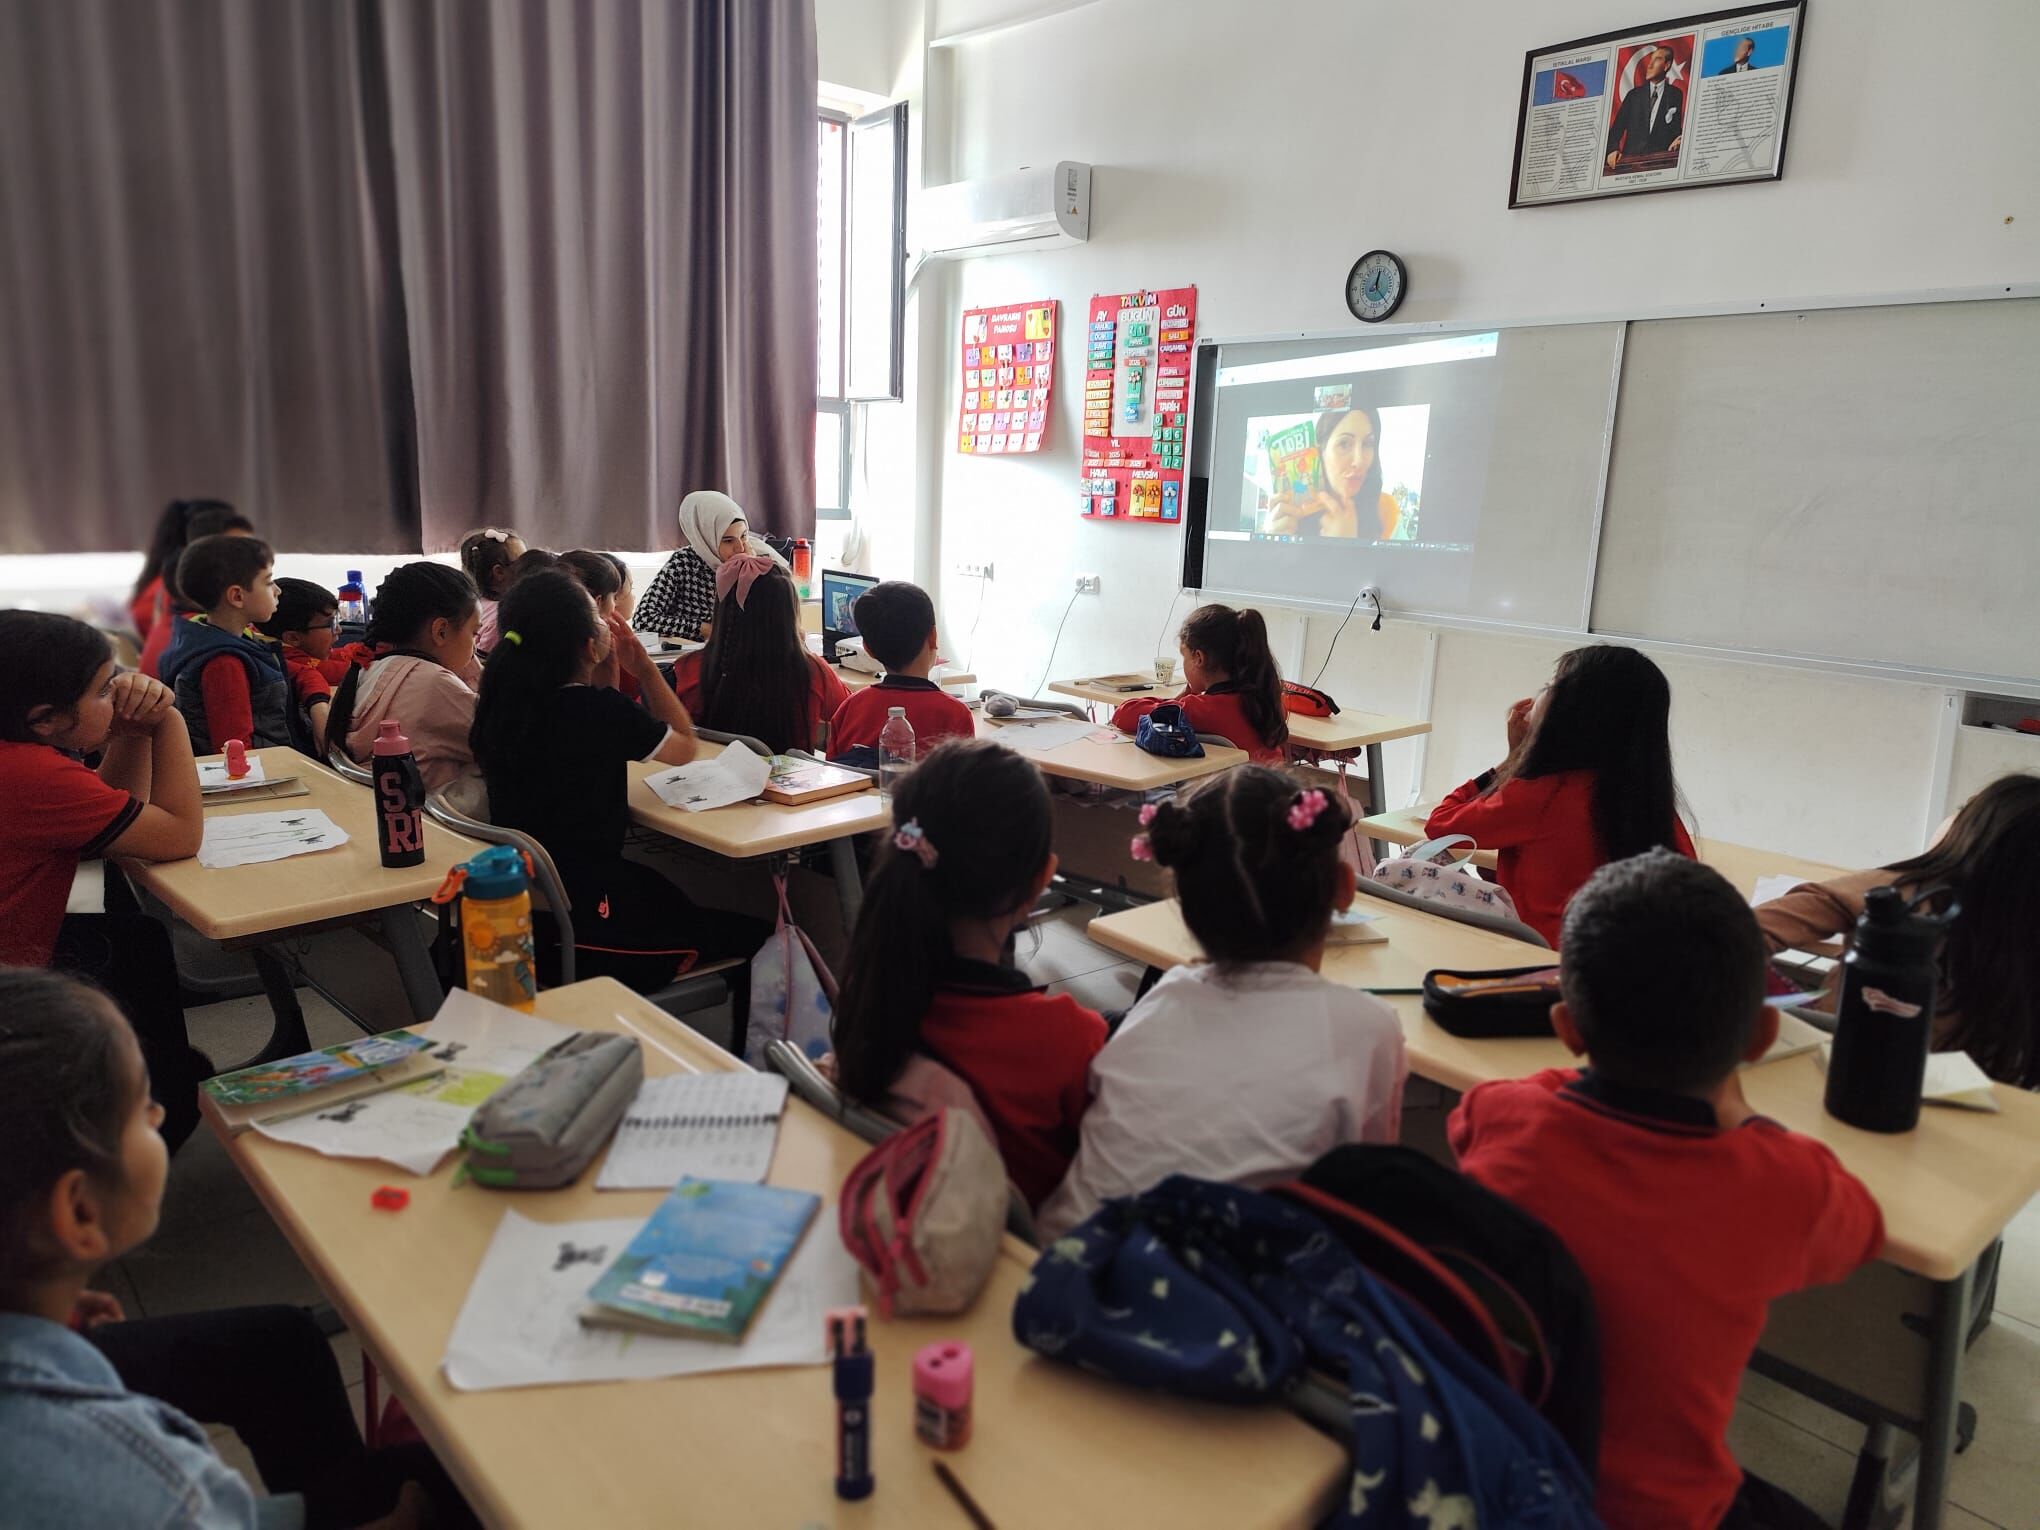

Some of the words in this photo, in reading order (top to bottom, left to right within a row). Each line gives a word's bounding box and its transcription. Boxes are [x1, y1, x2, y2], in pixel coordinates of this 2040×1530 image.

[1120, 293, 1157, 307] TAKVİM
[1096, 311, 1107, 322] AY
[1120, 309, 1154, 321] BUGÜN
[1166, 304, 1186, 317] GÜN
